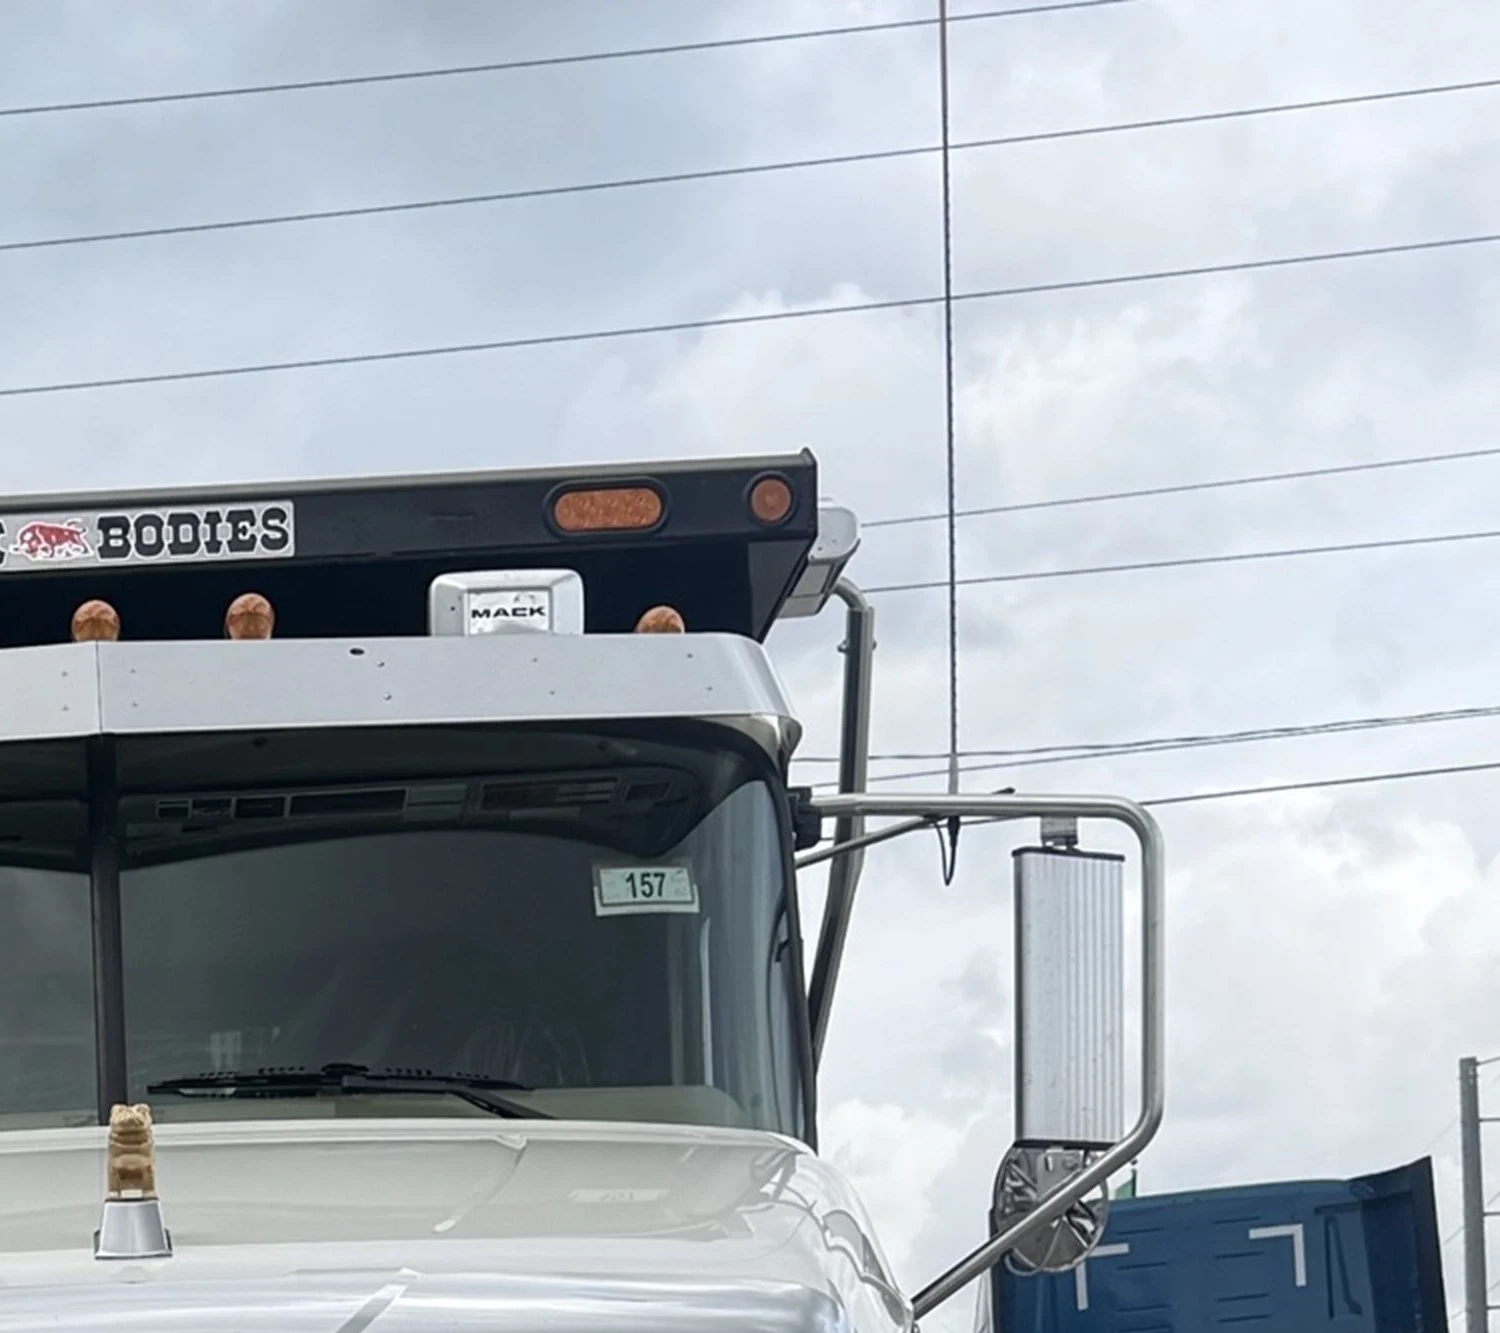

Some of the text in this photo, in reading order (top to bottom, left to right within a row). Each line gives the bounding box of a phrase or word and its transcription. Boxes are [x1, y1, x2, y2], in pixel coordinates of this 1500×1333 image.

[98, 507, 290, 559] BODIES
[471, 605, 546, 619] MACK
[625, 872, 666, 898] 157
